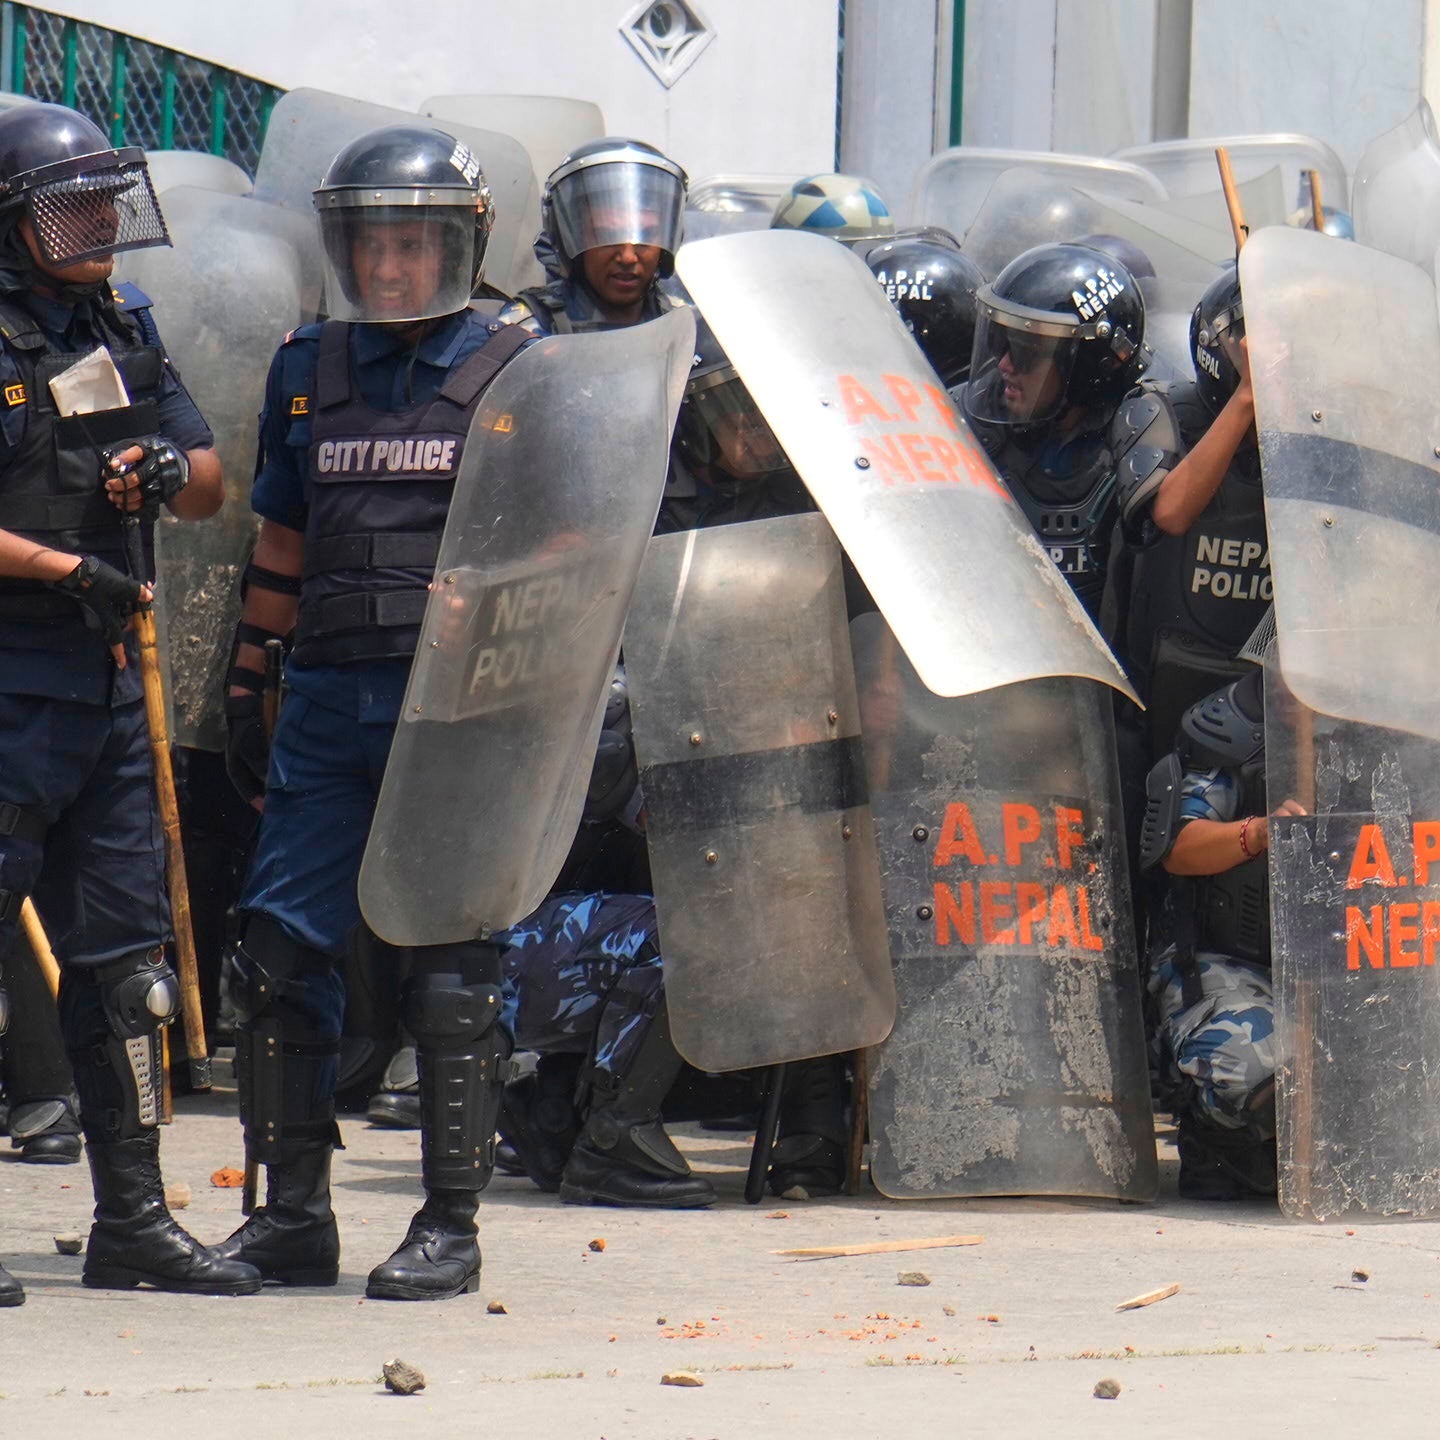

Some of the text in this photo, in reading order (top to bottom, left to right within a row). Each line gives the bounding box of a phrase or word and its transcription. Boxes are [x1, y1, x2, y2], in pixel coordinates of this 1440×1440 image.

[886, 285, 932, 301] EPAL
[1072, 268, 1116, 308] A.P.F.
[1078, 279, 1125, 321] NEPAL
[1196, 346, 1221, 380] NEPAL
[318, 439, 456, 473] CITY POLICE
[1191, 567, 1277, 601] POLIC
[932, 802, 1097, 872] A.P.F.
[933, 880, 1103, 950] NEPAL
